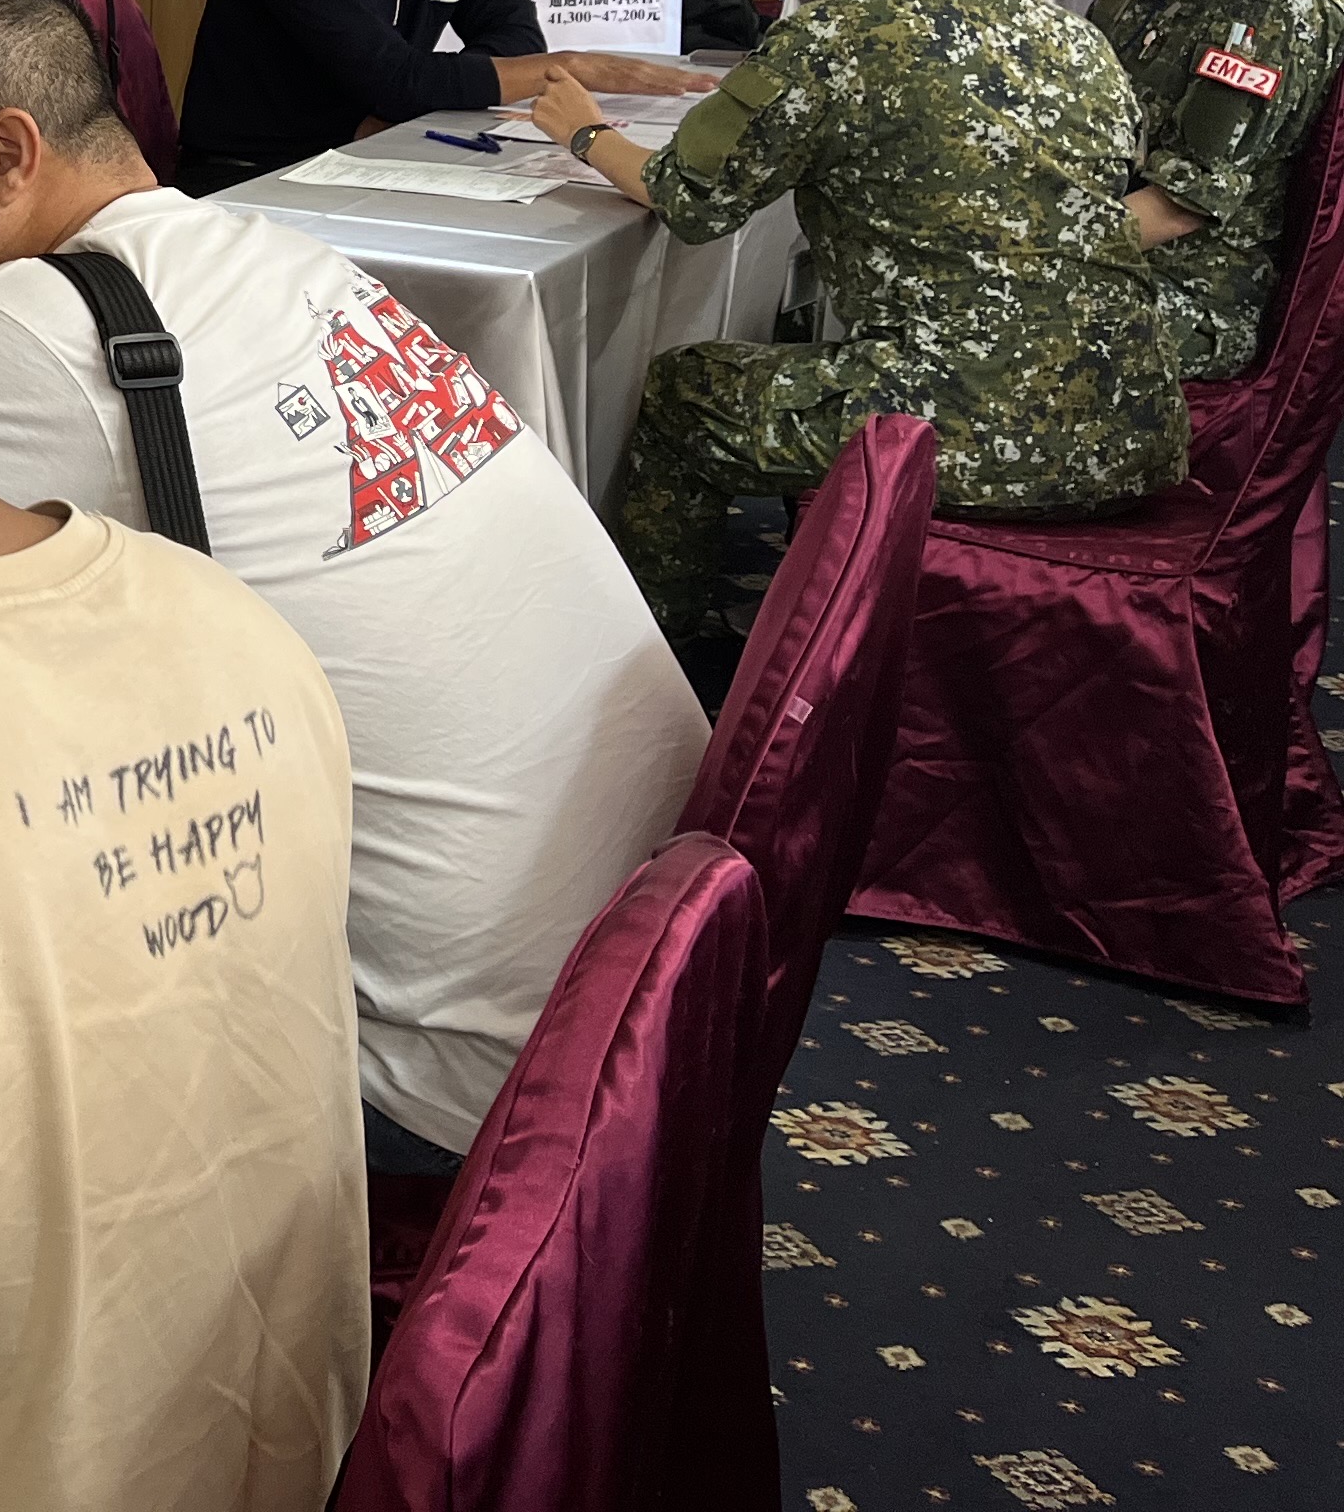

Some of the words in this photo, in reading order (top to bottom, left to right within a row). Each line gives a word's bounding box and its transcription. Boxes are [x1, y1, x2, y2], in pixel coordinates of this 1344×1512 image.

[1206, 54, 1271, 91] EMT-2
[15, 791, 31, 829] I
[57, 774, 93, 828] AM
[109, 724, 237, 814] TRYING
[243, 707, 275, 759] TO
[93, 844, 136, 898] BE
[150, 789, 264, 876] HAPPY
[142, 894, 228, 959] WOOD
